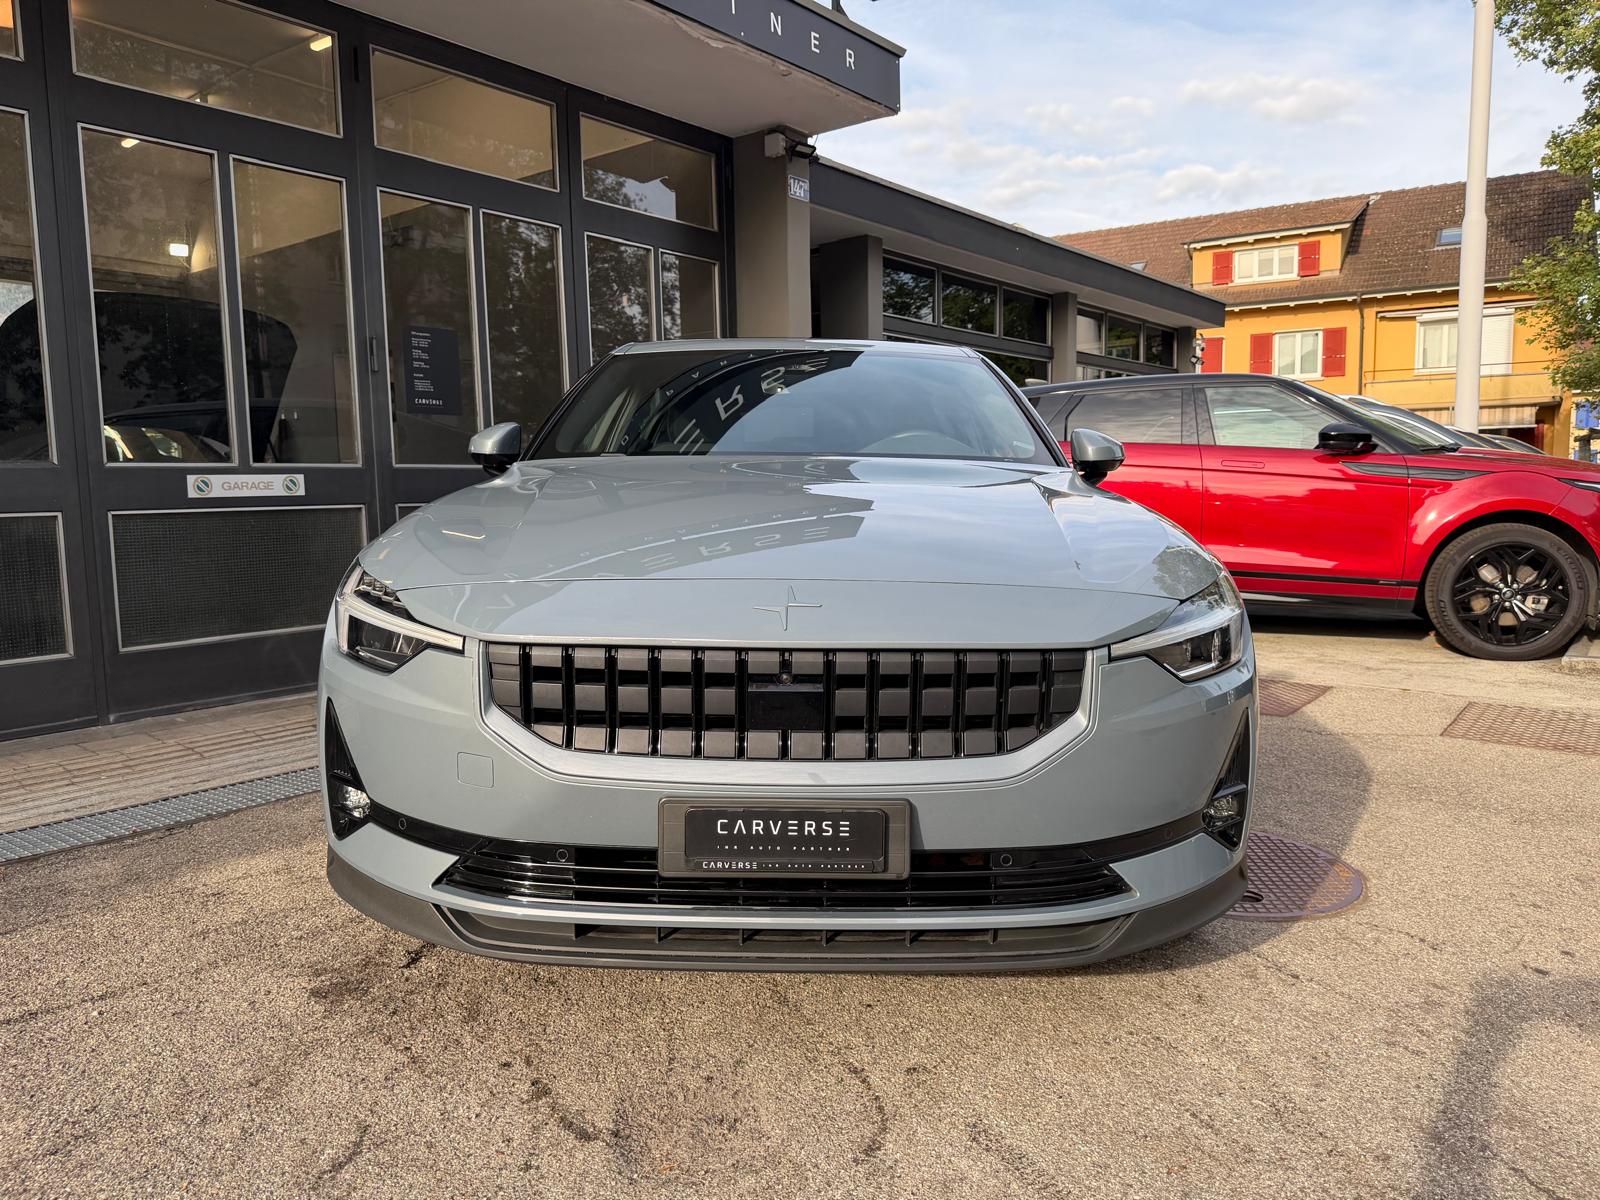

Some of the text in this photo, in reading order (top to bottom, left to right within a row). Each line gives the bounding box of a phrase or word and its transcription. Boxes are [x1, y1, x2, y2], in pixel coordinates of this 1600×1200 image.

[221, 481, 275, 491] GARAGE
[717, 819, 850, 836] CARVERSE
[702, 861, 758, 869] CARVERSE
